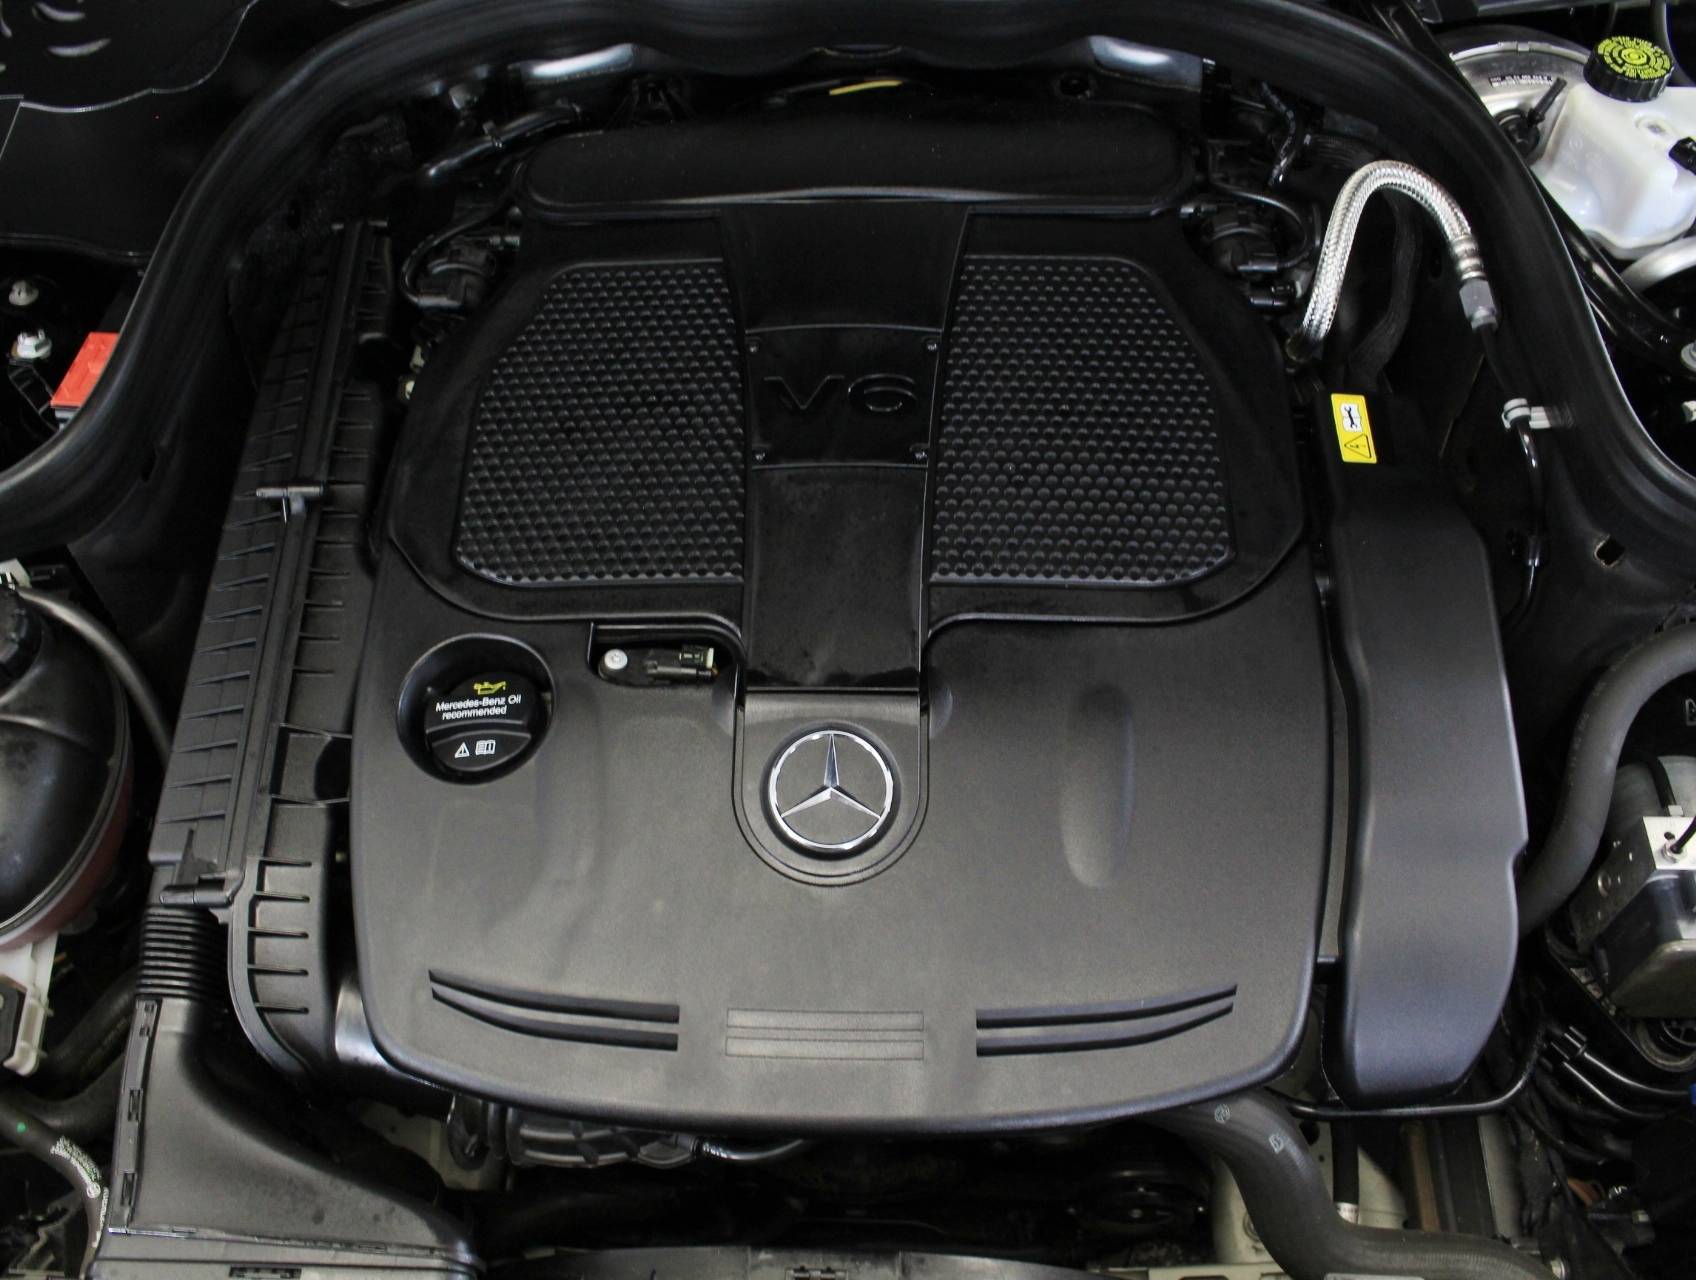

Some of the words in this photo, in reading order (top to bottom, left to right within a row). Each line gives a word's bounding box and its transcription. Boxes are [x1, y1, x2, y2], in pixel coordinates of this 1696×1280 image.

[762, 372, 918, 413] V6
[435, 696, 506, 712] Mercedes-Benz
[507, 694, 522, 705] Oil
[441, 705, 507, 720] recommended
